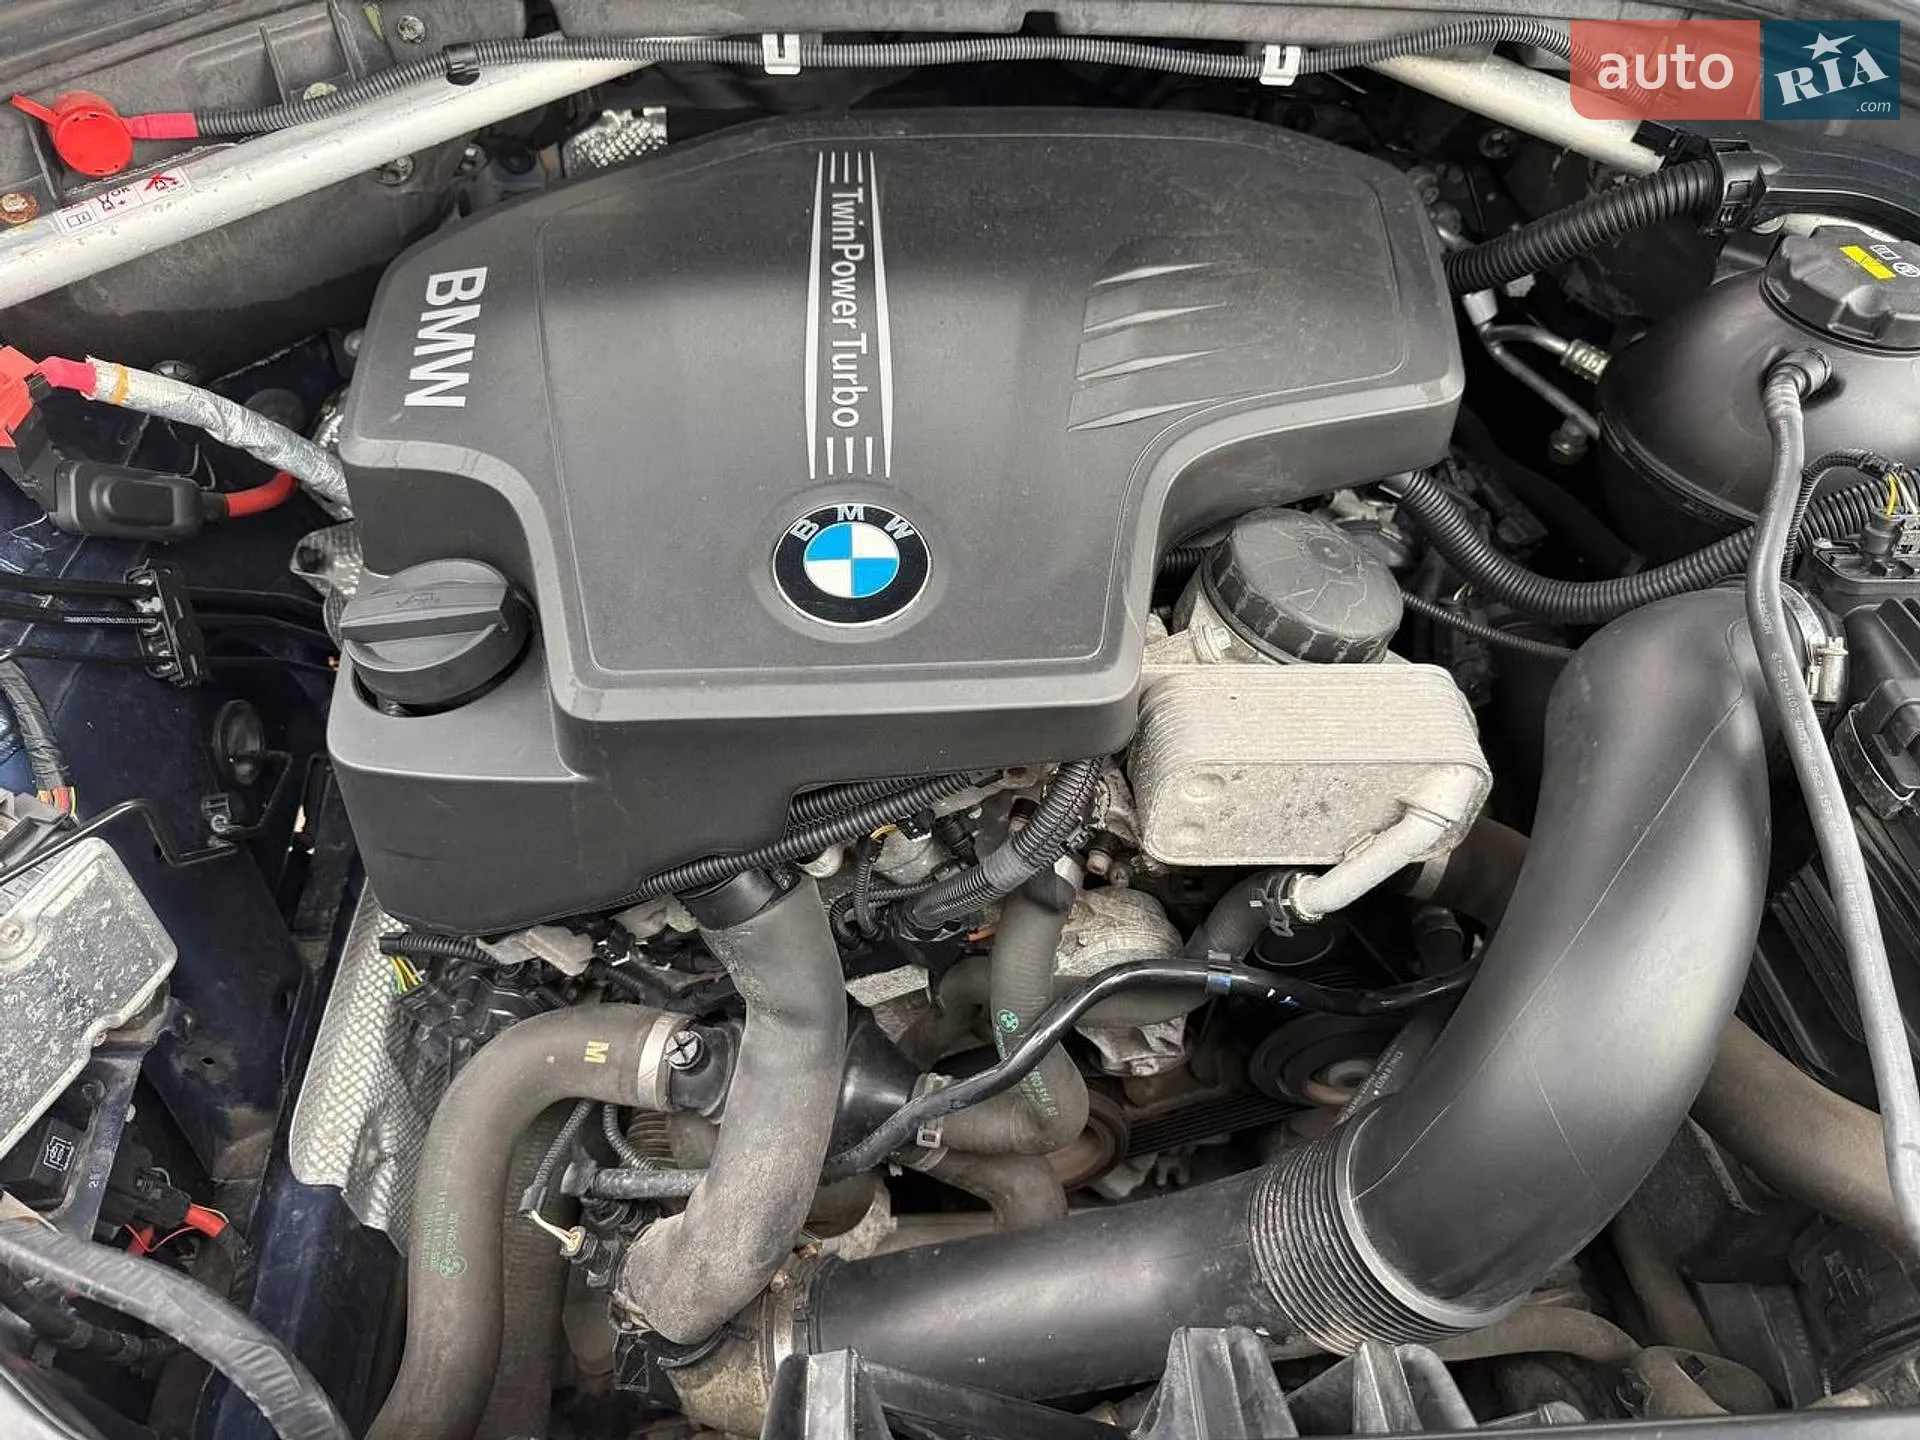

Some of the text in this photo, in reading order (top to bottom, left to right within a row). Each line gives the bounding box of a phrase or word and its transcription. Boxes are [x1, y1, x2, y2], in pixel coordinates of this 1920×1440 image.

[404, 266, 488, 408] BMW
[831, 187, 868, 428] TwinPower Turbo
[790, 505, 915, 542] BMW
[583, 1040, 610, 1064] M
